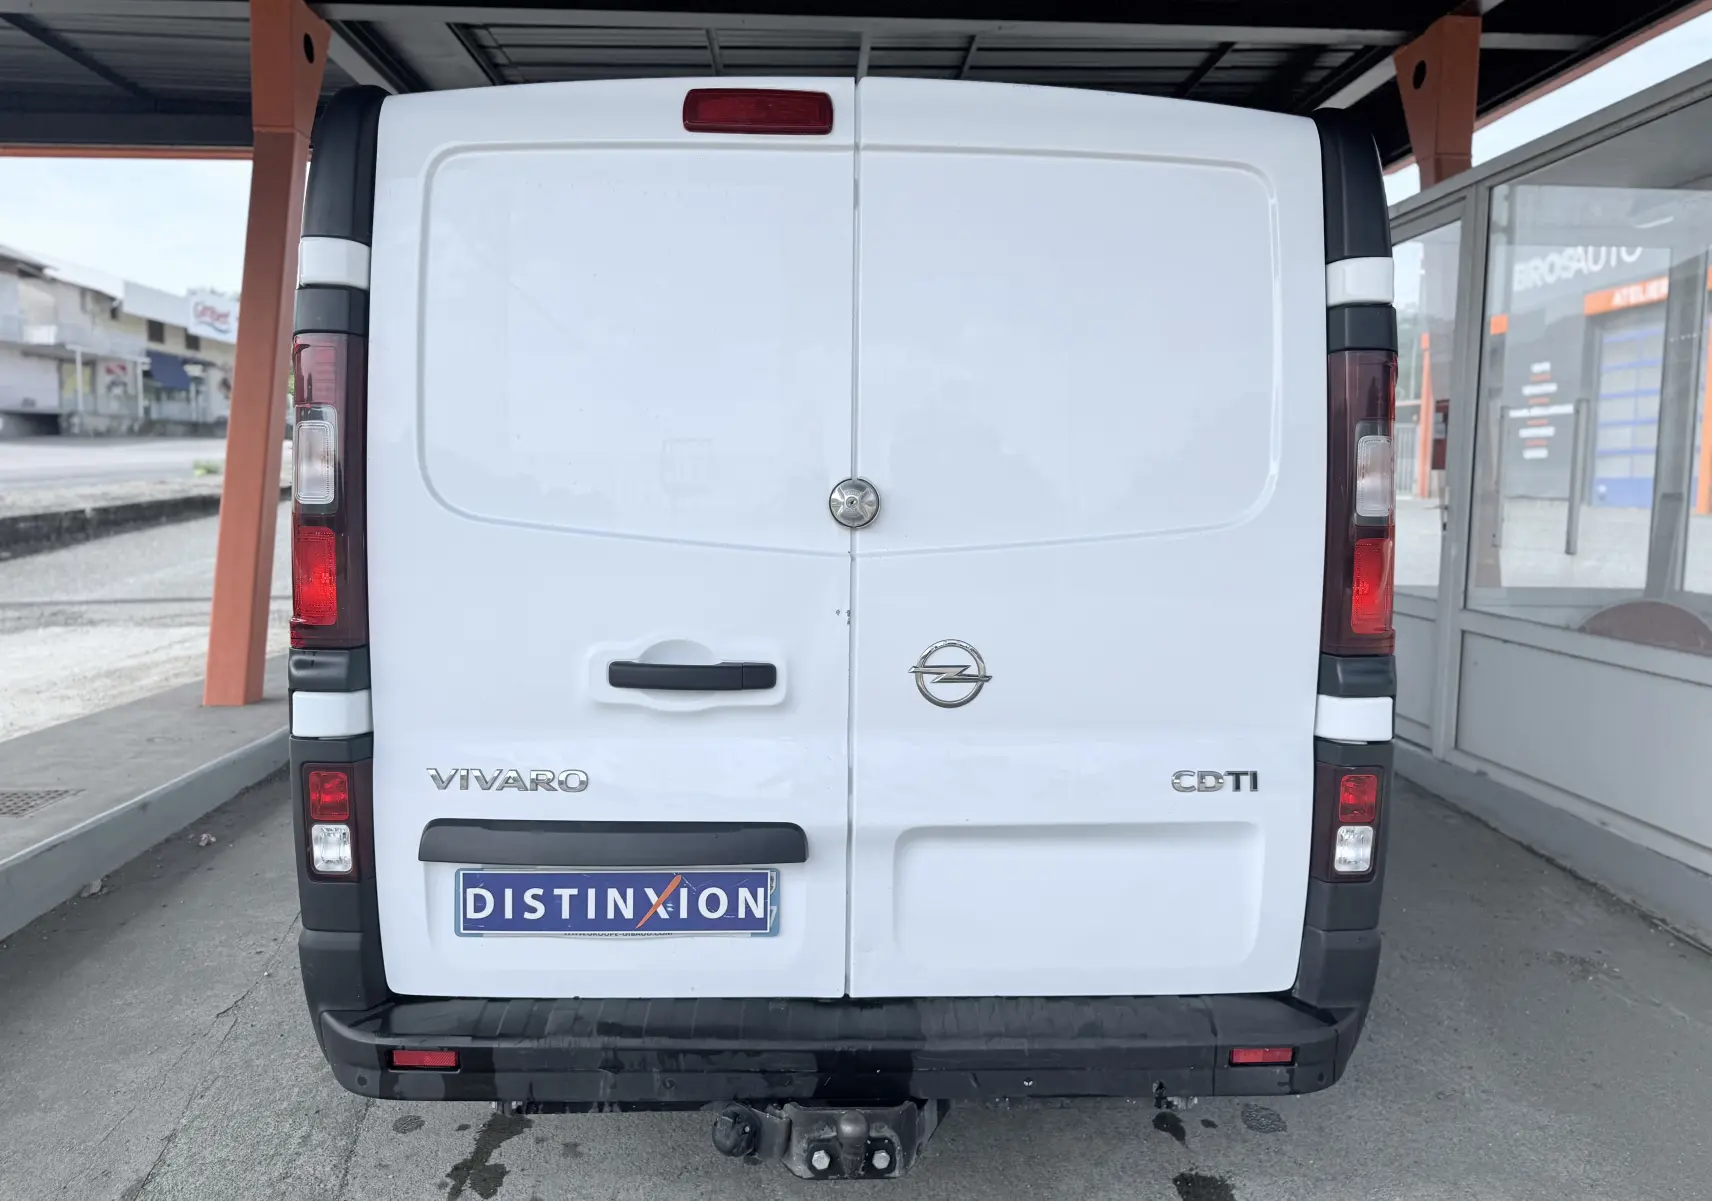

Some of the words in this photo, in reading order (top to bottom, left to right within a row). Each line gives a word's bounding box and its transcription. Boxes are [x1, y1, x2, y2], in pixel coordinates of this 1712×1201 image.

[427, 768, 589, 793] VIVARO
[1171, 770, 1259, 793] CDTI
[466, 880, 765, 923] DISTINXION
